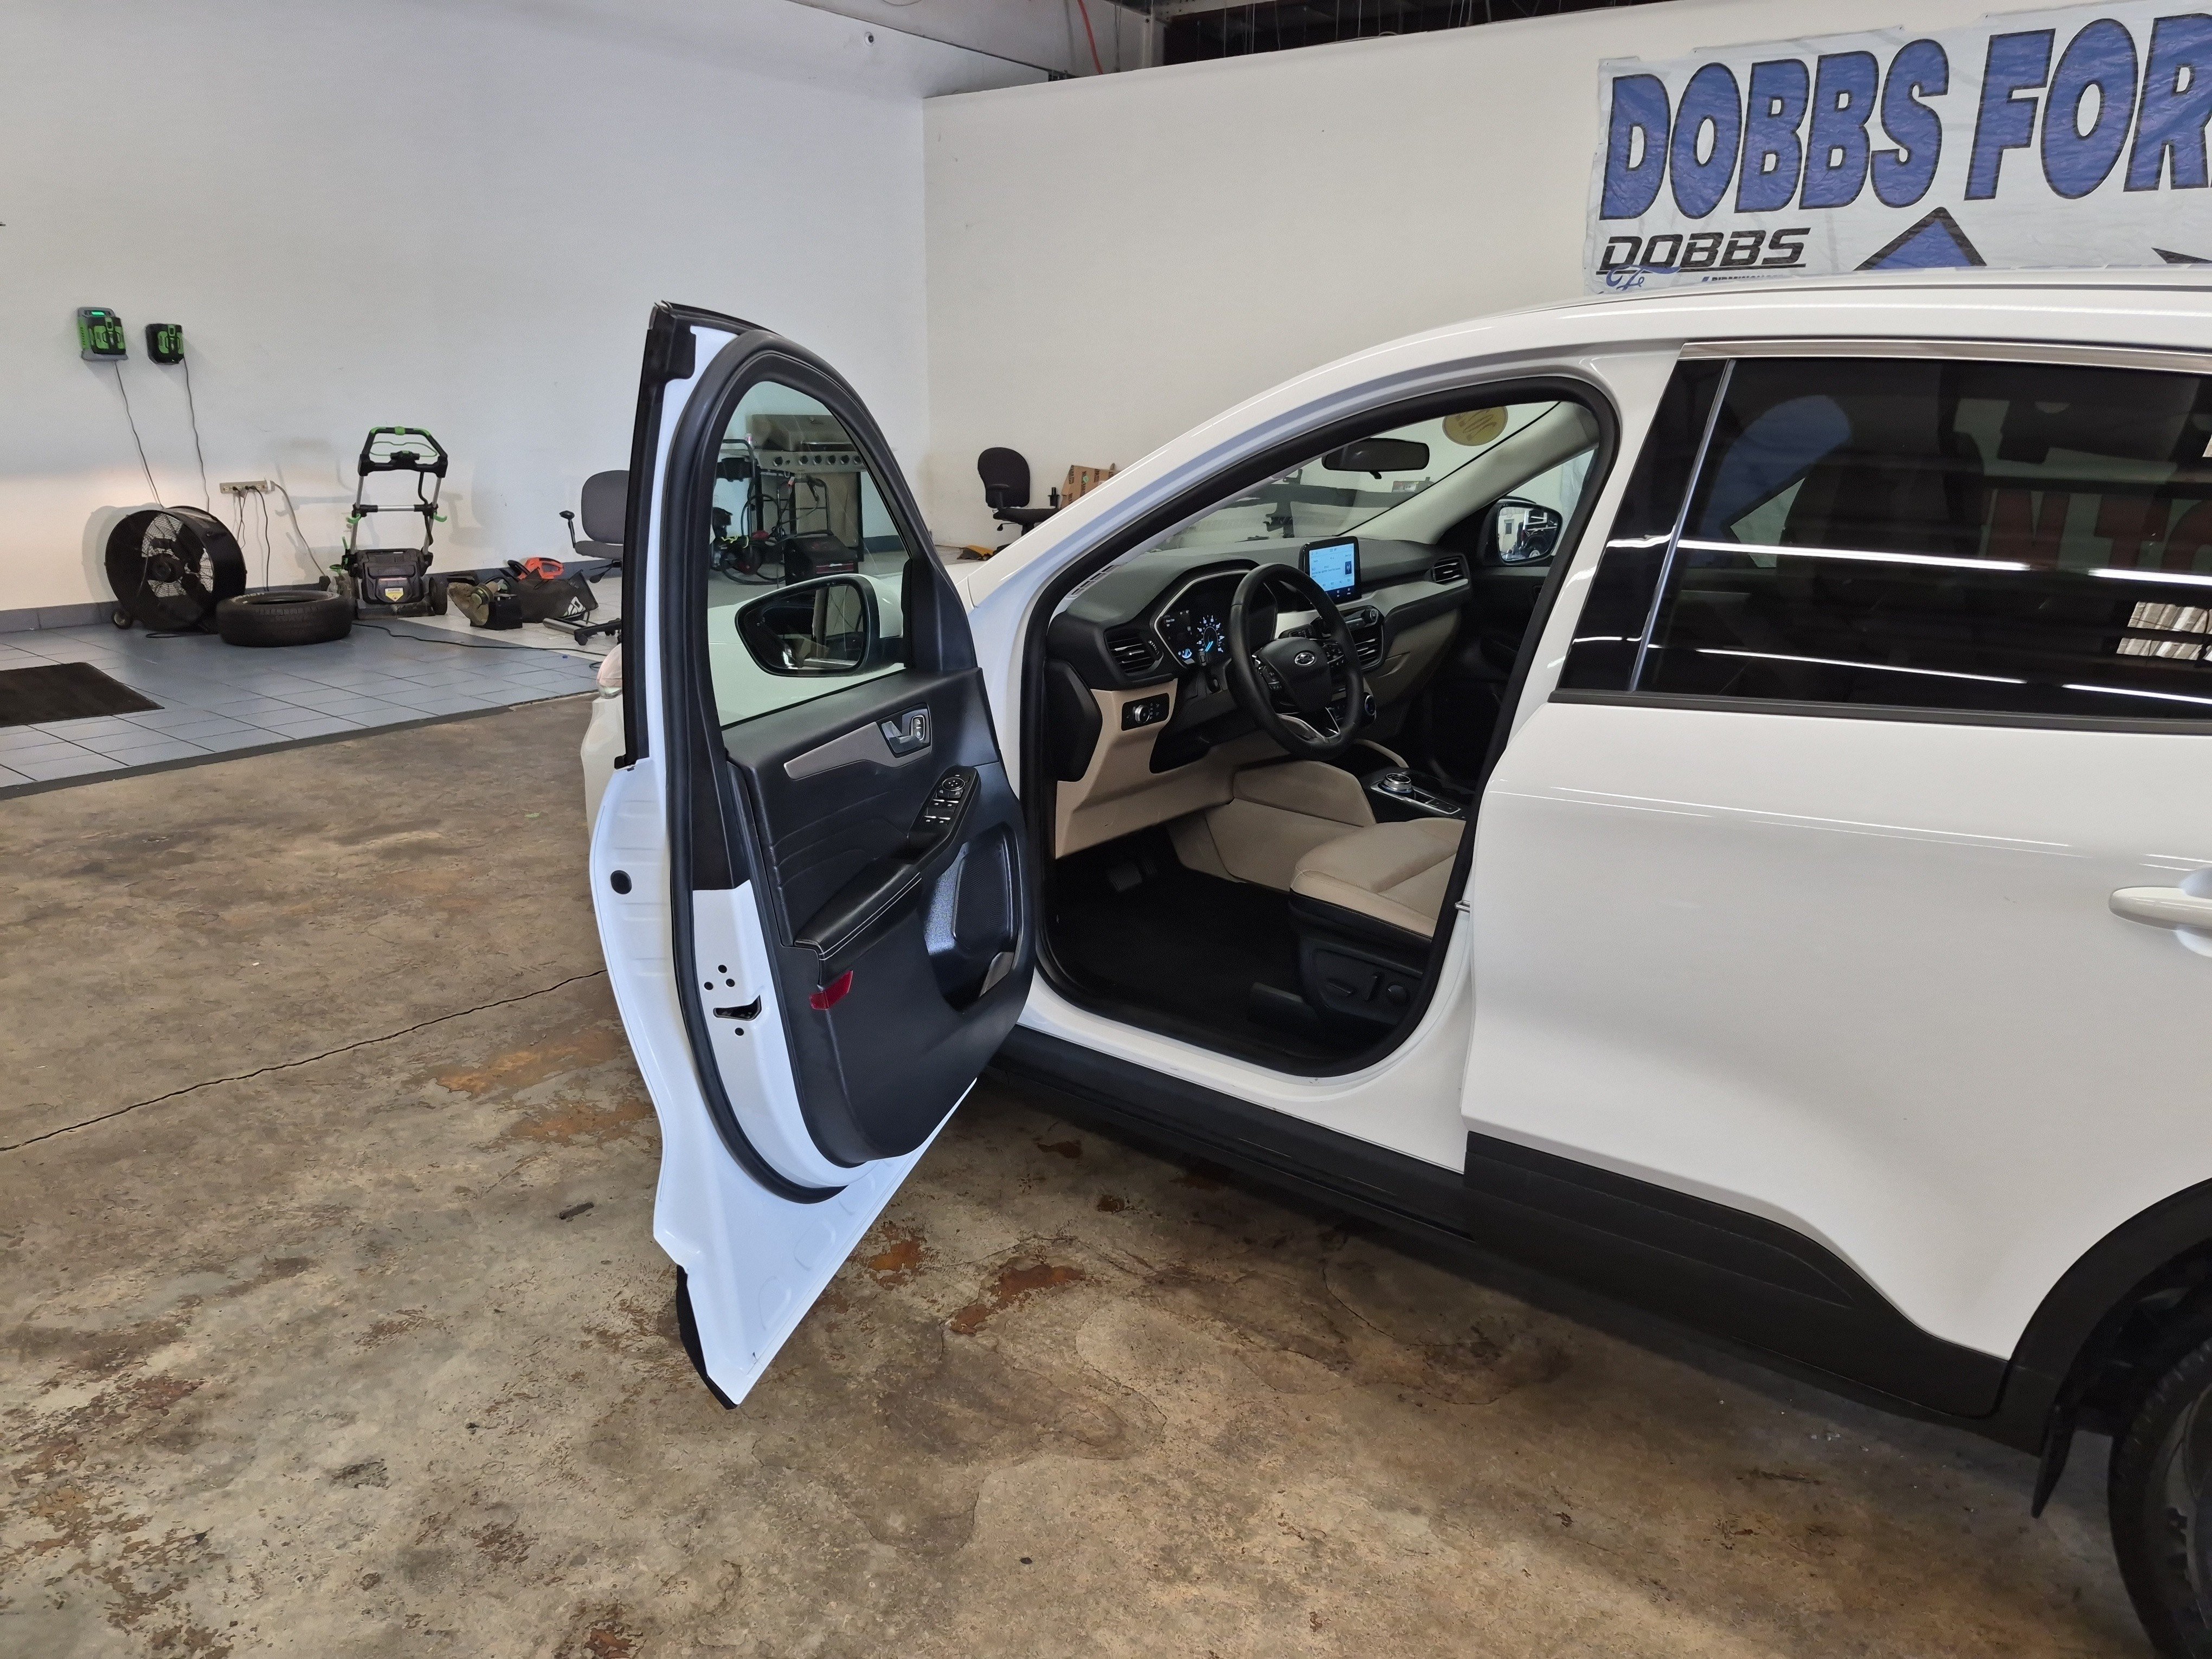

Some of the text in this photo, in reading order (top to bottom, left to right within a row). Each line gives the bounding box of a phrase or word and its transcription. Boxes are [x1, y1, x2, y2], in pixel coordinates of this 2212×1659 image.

[1599, 12, 2212, 220] DOBBS FOR
[1597, 228, 1811, 271] DOBBS
